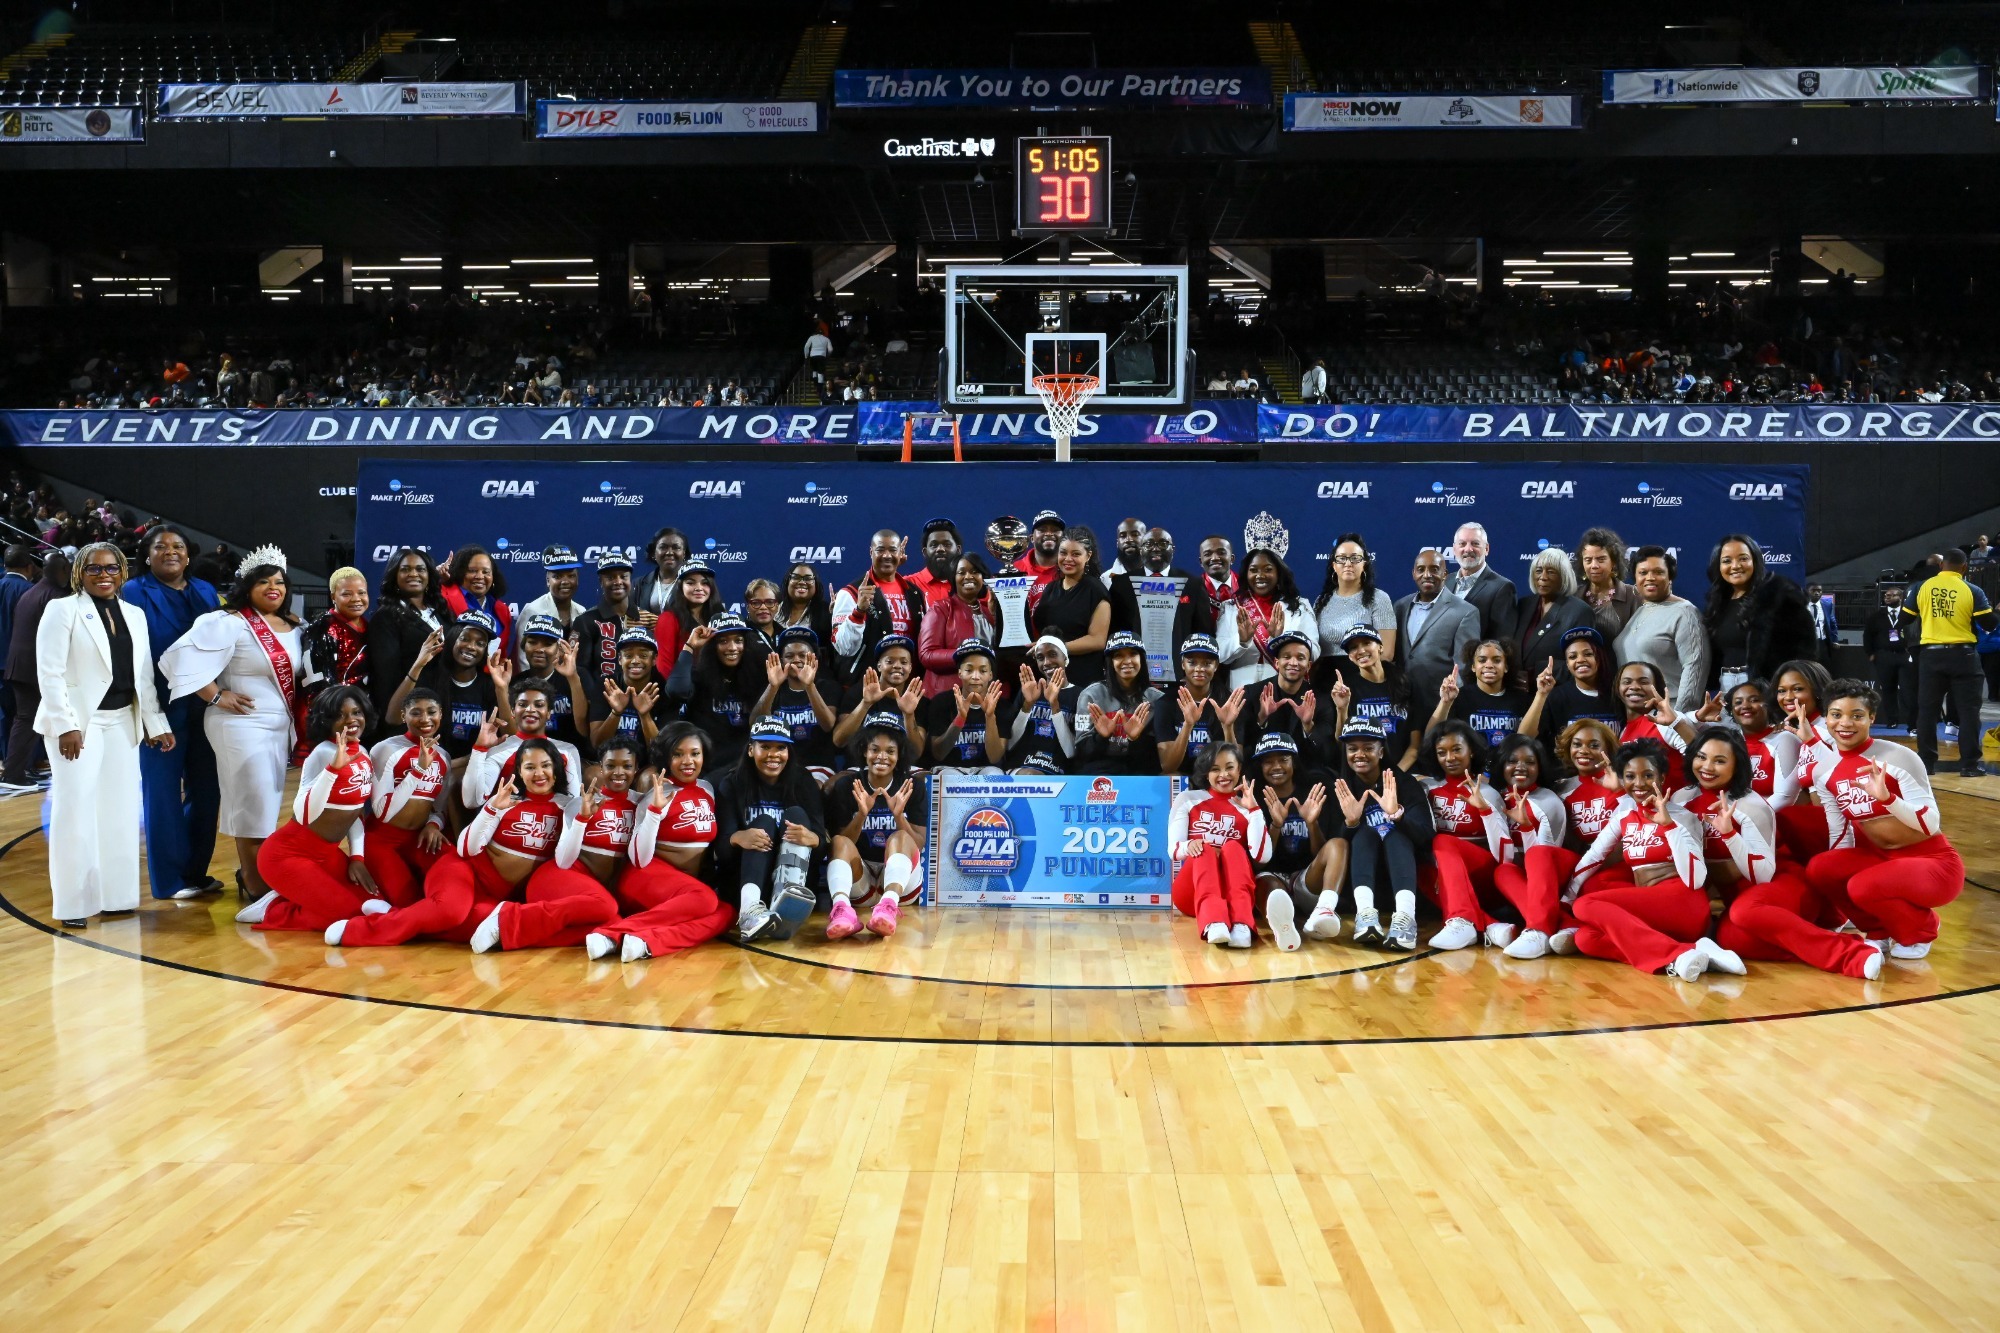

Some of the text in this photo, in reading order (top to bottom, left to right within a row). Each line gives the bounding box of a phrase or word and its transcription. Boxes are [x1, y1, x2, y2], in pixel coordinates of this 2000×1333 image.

[865, 75, 1242, 98] Thank You to Our Partners
[1678, 81, 1739, 92] Nationwide
[1877, 71, 1937, 94] Sprite
[196, 92, 269, 108] BEVEL
[759, 107, 782, 115] GOOD
[1351, 101, 1401, 116] NOW
[557, 111, 618, 127] DTLR
[637, 112, 723, 125] FOOD LION
[25, 123, 53, 131] ROTC
[1029, 148, 1100, 173] 51:05
[1040, 176, 1091, 221] 30
[956, 384, 984, 394] CIAA
[41, 418, 258, 445] EVENTS,
[306, 416, 499, 441] DINING
[540, 416, 654, 440] AND
[699, 414, 854, 439] MORE
[1282, 413, 1380, 438] DO!
[319, 487, 358, 496] CLUB E
[482, 480, 535, 498] CIAA
[690, 481, 742, 498] CIAA
[1317, 481, 1369, 498] CIAA
[1521, 481, 1574, 498] CIAA
[1729, 483, 1784, 501] CIAA
[403, 491, 434, 505] YOURS
[613, 492, 643, 506] YOURS
[818, 493, 848, 506] YOURS
[1445, 493, 1475, 506] YOURS
[1651, 493, 1682, 507] YOURS
[510, 548, 541, 562] YOURS
[718, 549, 748, 563] YOURS
[790, 546, 842, 563] CIAA
[995, 578, 1026, 588] CIAA
[1140, 582, 1176, 594] CIAA
[1931, 587, 1957, 599] CSC
[1931, 598, 1956, 610] EVENT
[1932, 608, 1955, 619] STAFF
[1565, 630, 1592, 641] CIAA
[880, 639, 906, 648] CIAA
[946, 785, 1053, 795] WOMEN'S BASKETBALL
[1059, 804, 1153, 825] TICKET
[1571, 808, 1612, 828] State
[964, 830, 1010, 838] FOOD LION
[1189, 821, 1241, 840] State
[1062, 826, 1149, 854] 2026
[1623, 834, 1664, 850] State
[955, 838, 1015, 859] CIAA
[1044, 856, 1166, 877] PUNCHED
